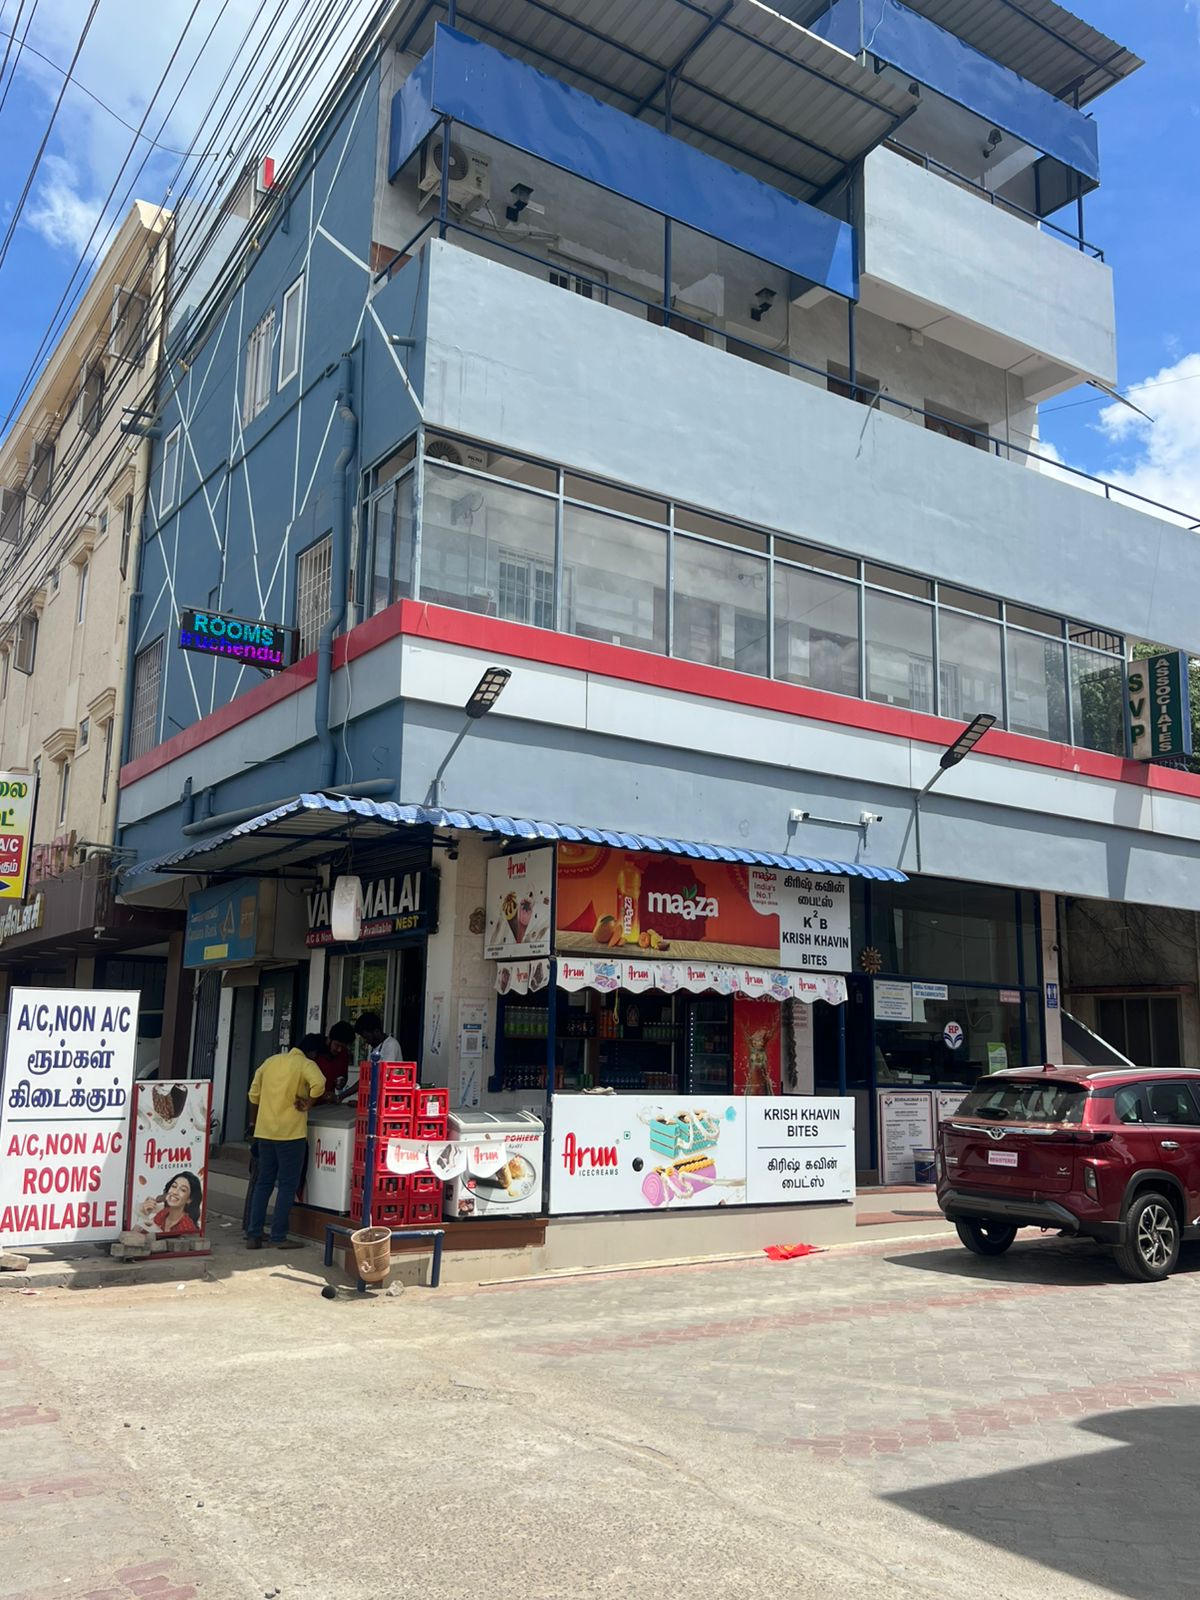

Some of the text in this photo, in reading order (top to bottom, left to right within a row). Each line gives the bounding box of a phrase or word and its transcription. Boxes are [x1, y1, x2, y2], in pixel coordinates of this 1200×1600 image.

[193, 614, 274, 646] ROOMS
[1155, 658, 1173, 752] ASSOCIATES
[307, 872, 421, 928] VAMALAI
[648, 891, 719, 920] maaza
[396, 915, 418, 930] NEST
[782, 931, 849, 948] KRISH KHAVIN
[801, 954, 828, 967] BITES
[563, 963, 586, 979] Arun
[628, 966, 649, 980] Arun
[688, 967, 706, 981] Arun
[745, 971, 764, 986] Arun
[799, 977, 817, 991] Arun
[101, 1006, 131, 1032] A/C
[948, 1026, 959, 1034] HP
[28, 1039, 115, 1075] ரூம்கள்
[8, 1076, 127, 1113] கிடைக்கும்
[764, 1109, 840, 1121] KRISH KHAVIN
[787, 1125, 819, 1138] BITES
[92, 1132, 122, 1154] A/C
[144, 1138, 193, 1169] Arun
[316, 1138, 336, 1168] Arun
[394, 1144, 419, 1162] Arun
[474, 1146, 499, 1164] Arun
[562, 1132, 618, 1176] Arun
[579, 1168, 619, 1176] ICECREAMS
[767, 1157, 838, 1173] கிரிஷ் கவின்
[23, 1165, 102, 1195] ROOMS
[782, 1175, 825, 1189] பைட்ஸ்
[0, 1201, 117, 1232] AVAILABLE
